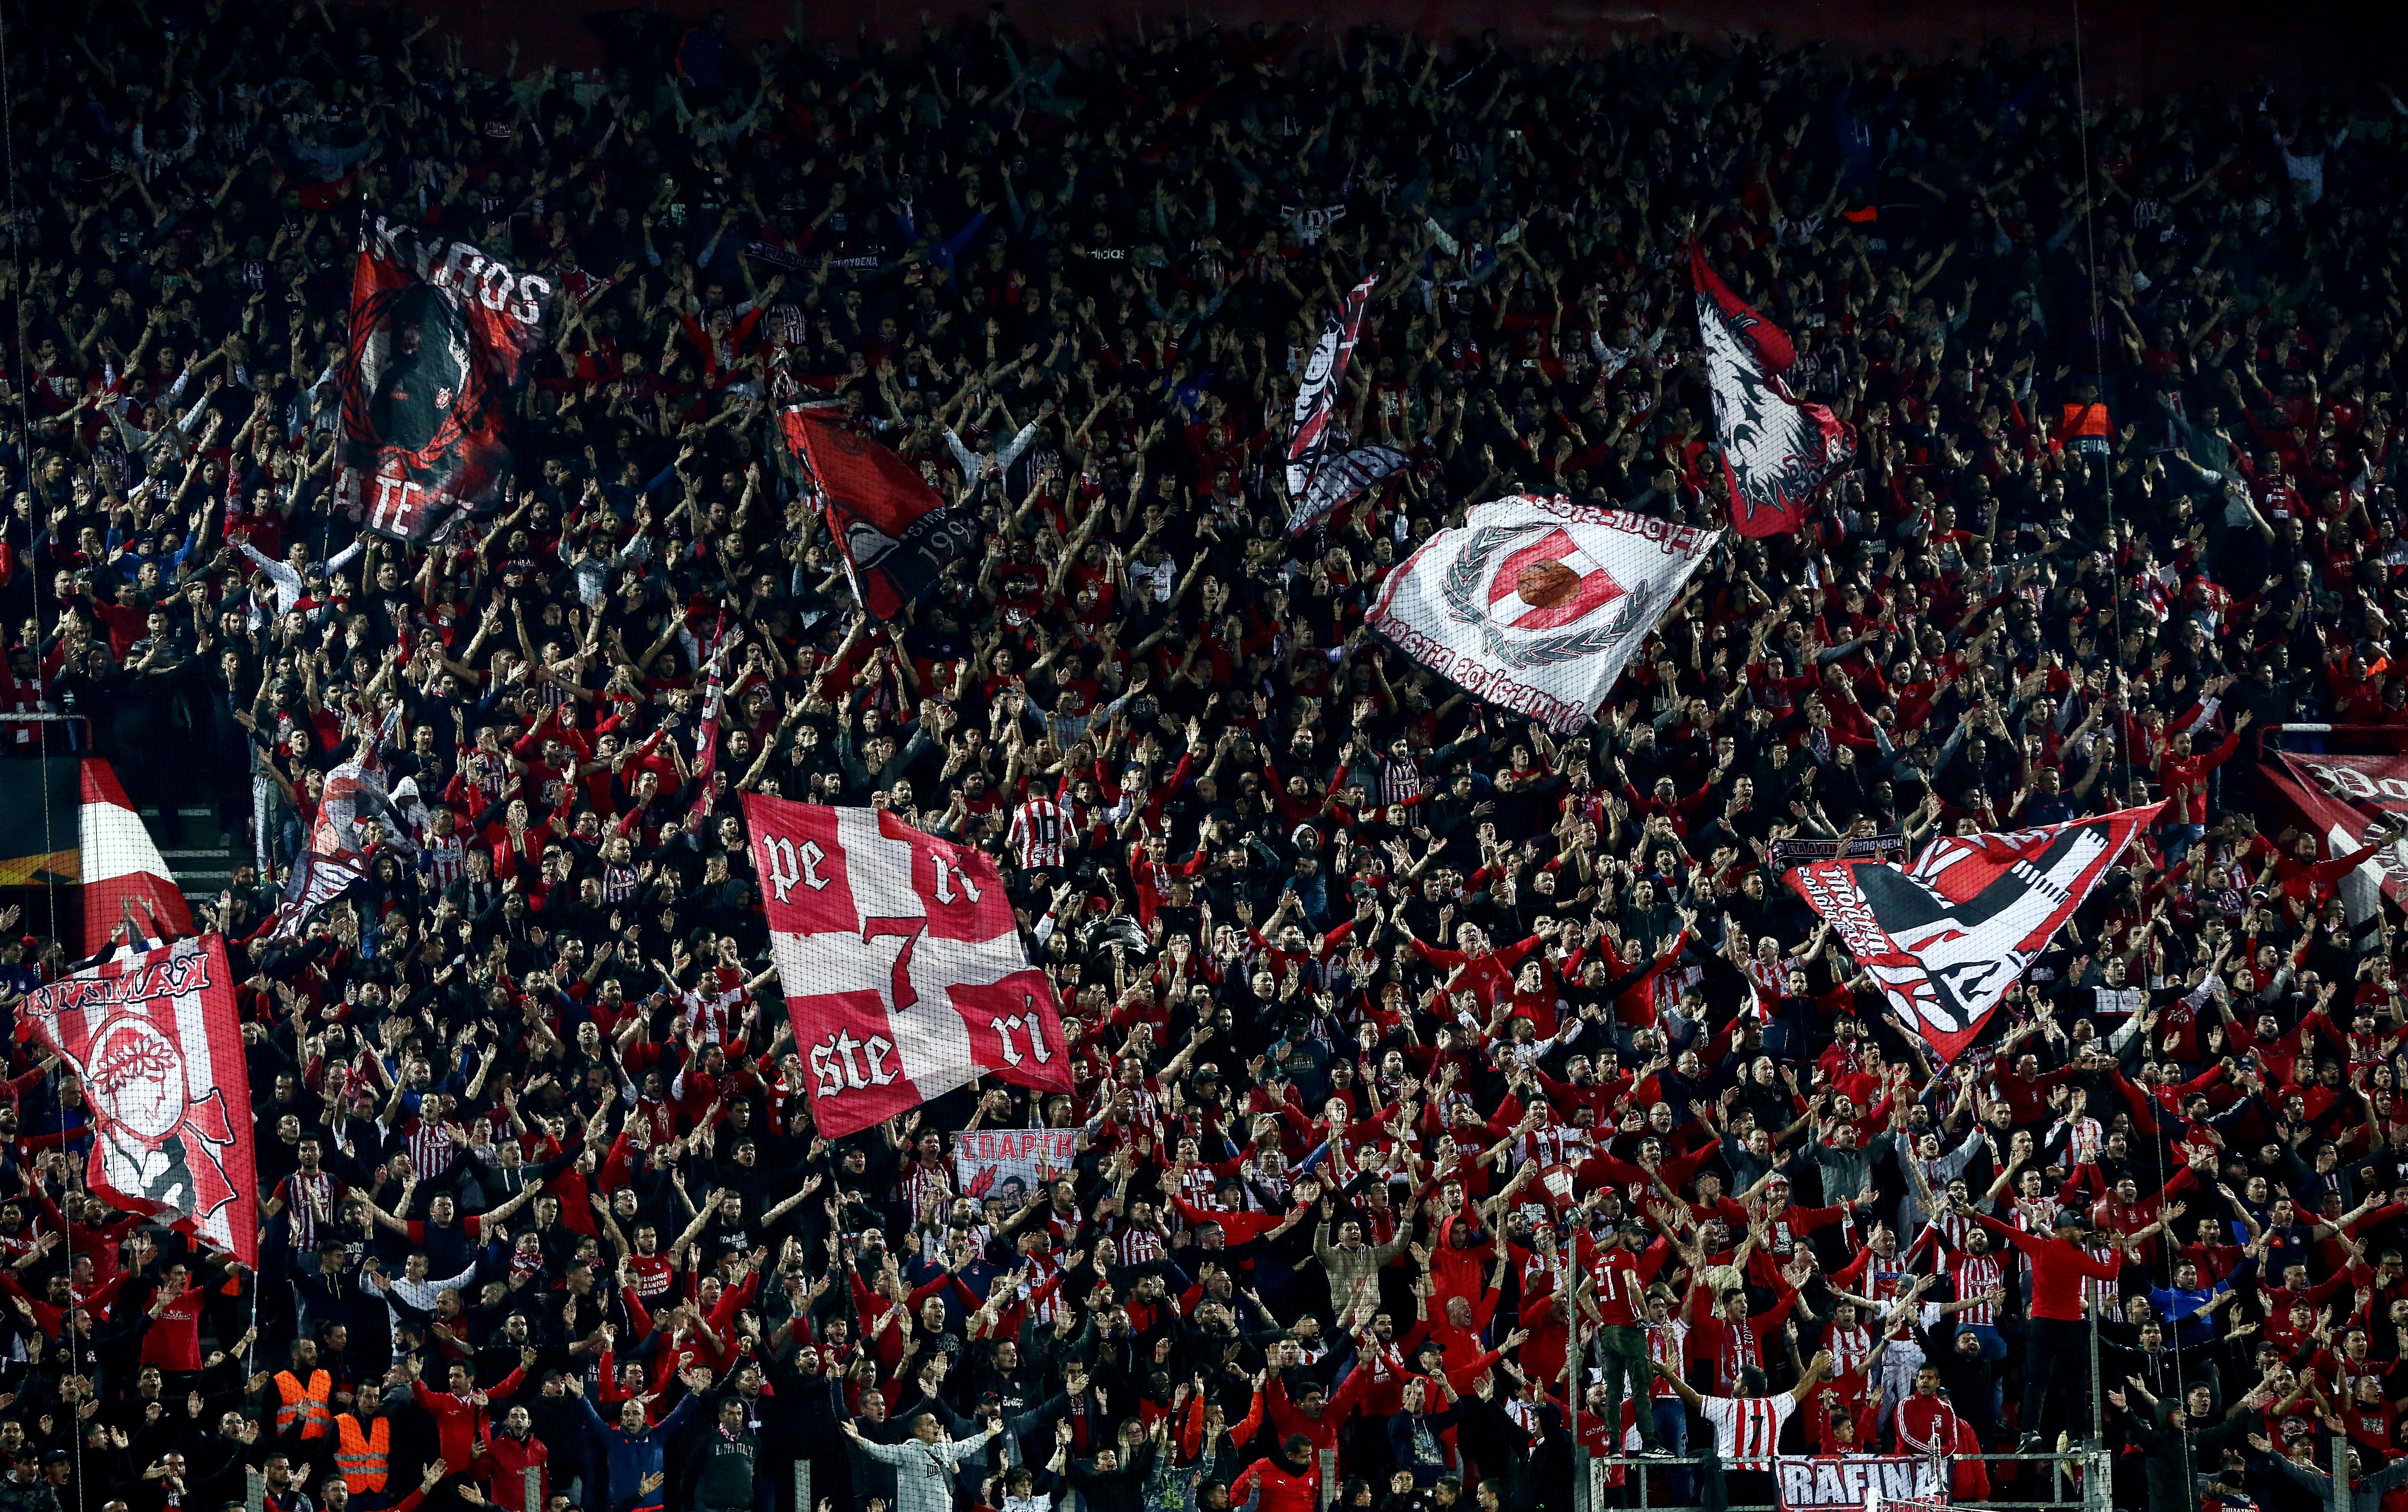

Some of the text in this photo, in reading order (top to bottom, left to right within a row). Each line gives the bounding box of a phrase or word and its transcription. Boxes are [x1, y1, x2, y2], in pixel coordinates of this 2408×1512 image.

[863, 916, 927, 1012] 7
[810, 1027, 899, 1099] ste
[961, 1131, 1074, 1160] ΣΠΑΡΤΗ
[643, 1280, 667, 1289] ALWAYS
[1595, 1265, 1616, 1302] 21
[1750, 1415, 1764, 1449] 7
[1782, 1460, 1944, 1505] RAFINA
